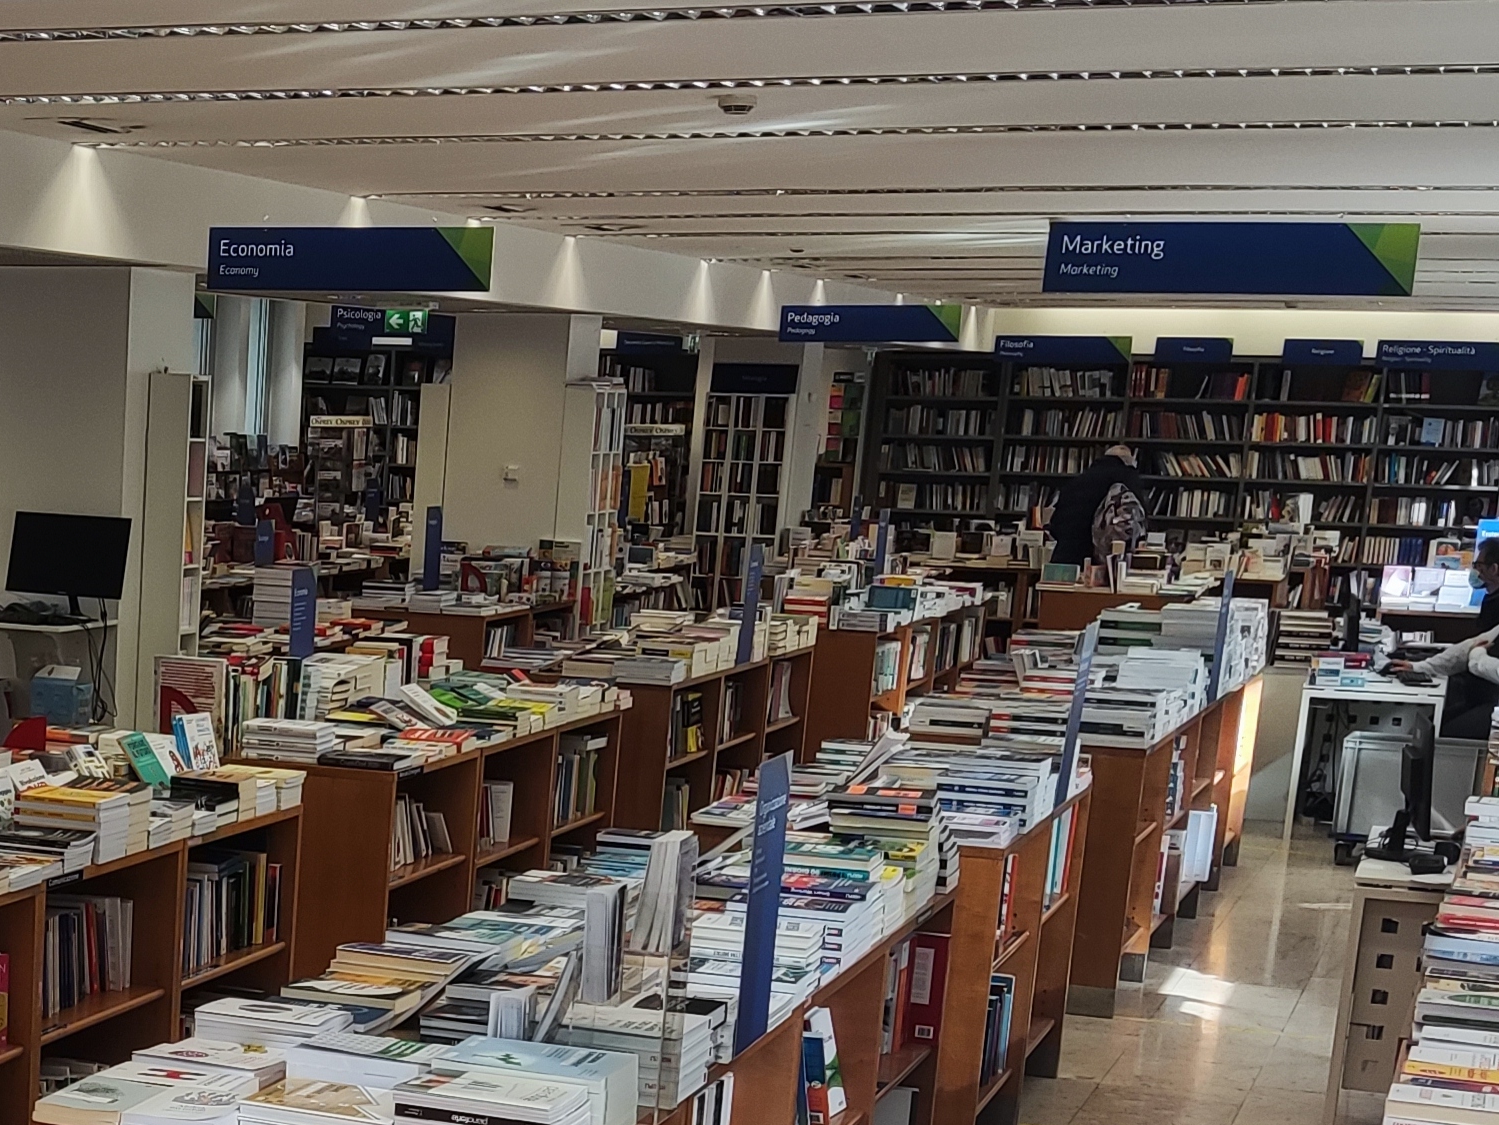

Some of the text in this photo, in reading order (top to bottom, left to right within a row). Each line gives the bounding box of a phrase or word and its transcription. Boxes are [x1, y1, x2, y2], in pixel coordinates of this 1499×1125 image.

[219, 239, 294, 257] Economia
[1061, 234, 1165, 260] Marketing
[219, 264, 259, 277] Economy
[1059, 263, 1119, 278] Marketing
[337, 308, 382, 322] Psicologia
[787, 312, 840, 325] Pedagogia
[1000, 339, 1034, 349] Filosofia
[1382, 344, 1476, 357] Religione Spiritualità
